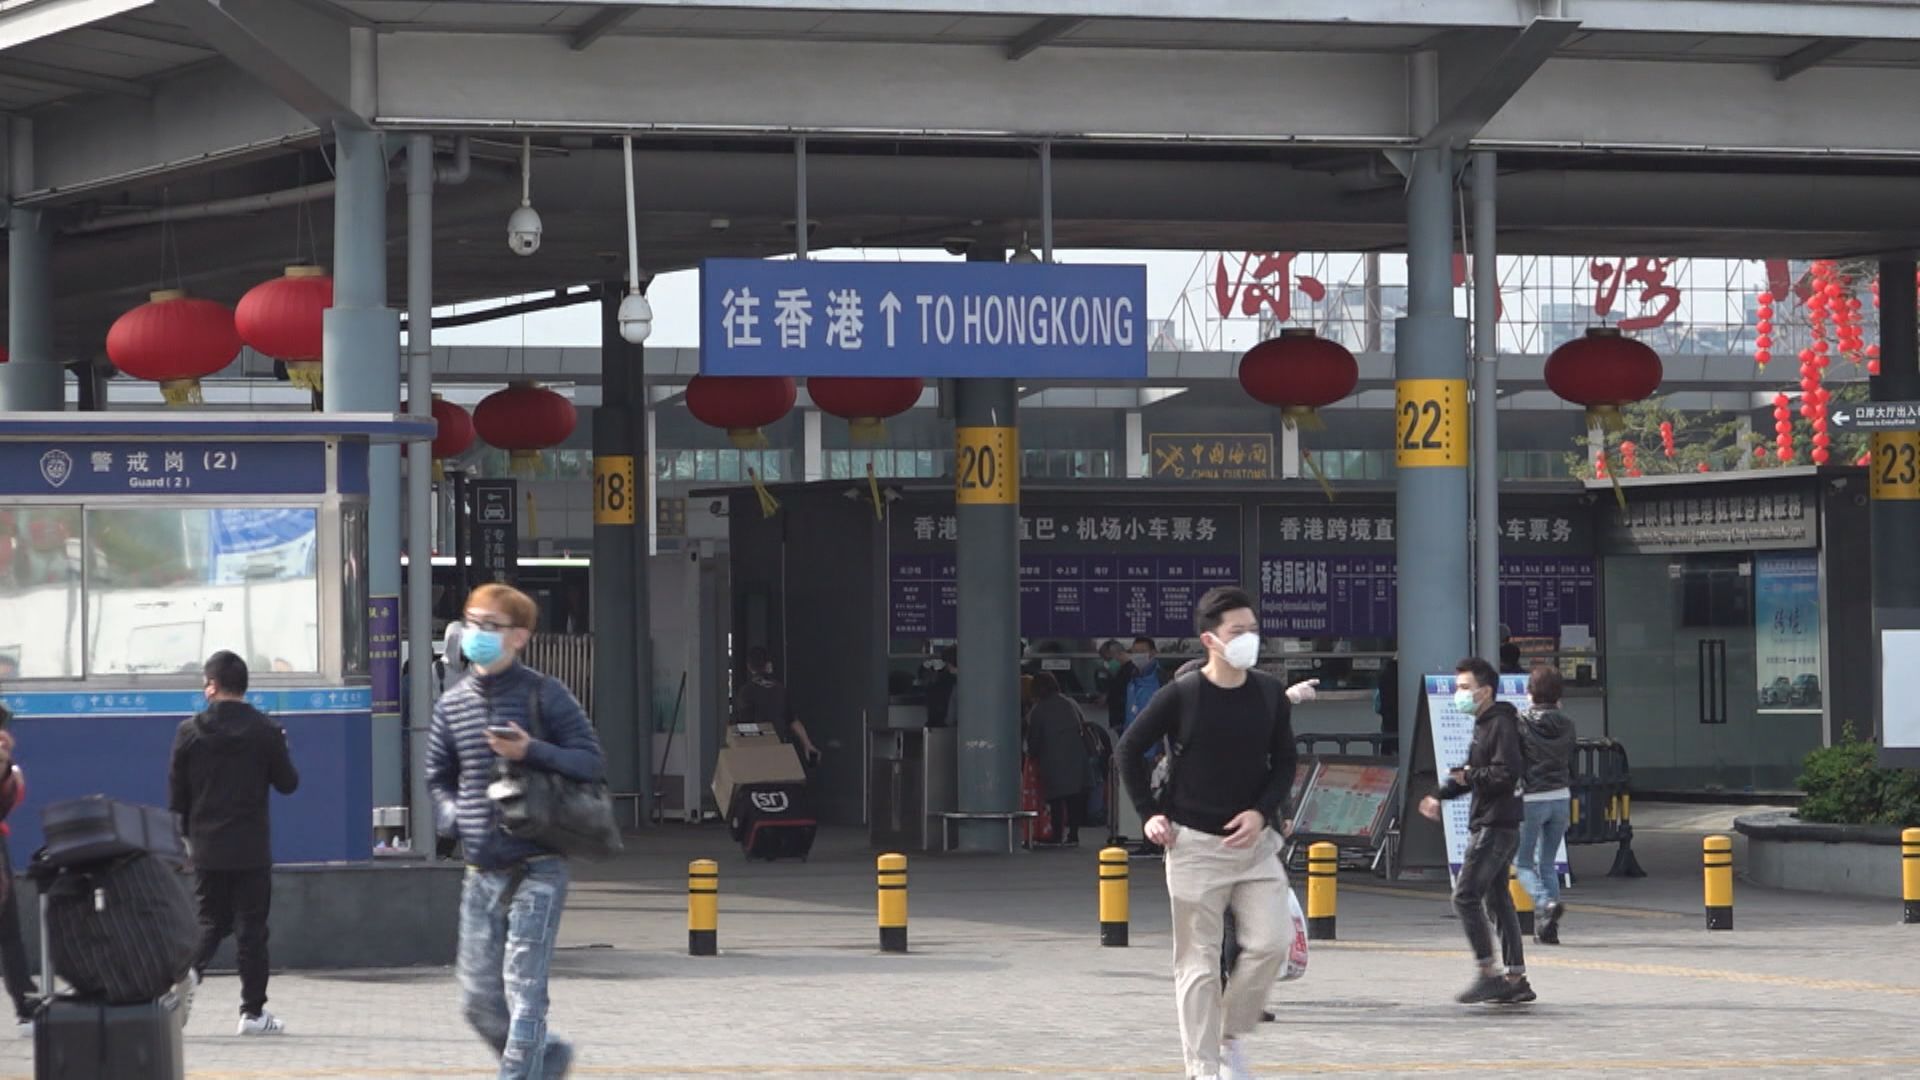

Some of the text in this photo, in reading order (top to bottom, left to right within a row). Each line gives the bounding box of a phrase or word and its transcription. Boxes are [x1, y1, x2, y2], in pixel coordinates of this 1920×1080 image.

[722, 287, 864, 349] 往香港
[916, 295, 1133, 346] TO HONGKONG
[1403, 400, 1442, 450] 22
[962, 445, 995, 488] 20
[1191, 442, 1266, 465] 中国海关
[1882, 443, 1916, 484] 23
[597, 473, 625, 512] 18
[1261, 560, 1328, 594] 香港国际机场
